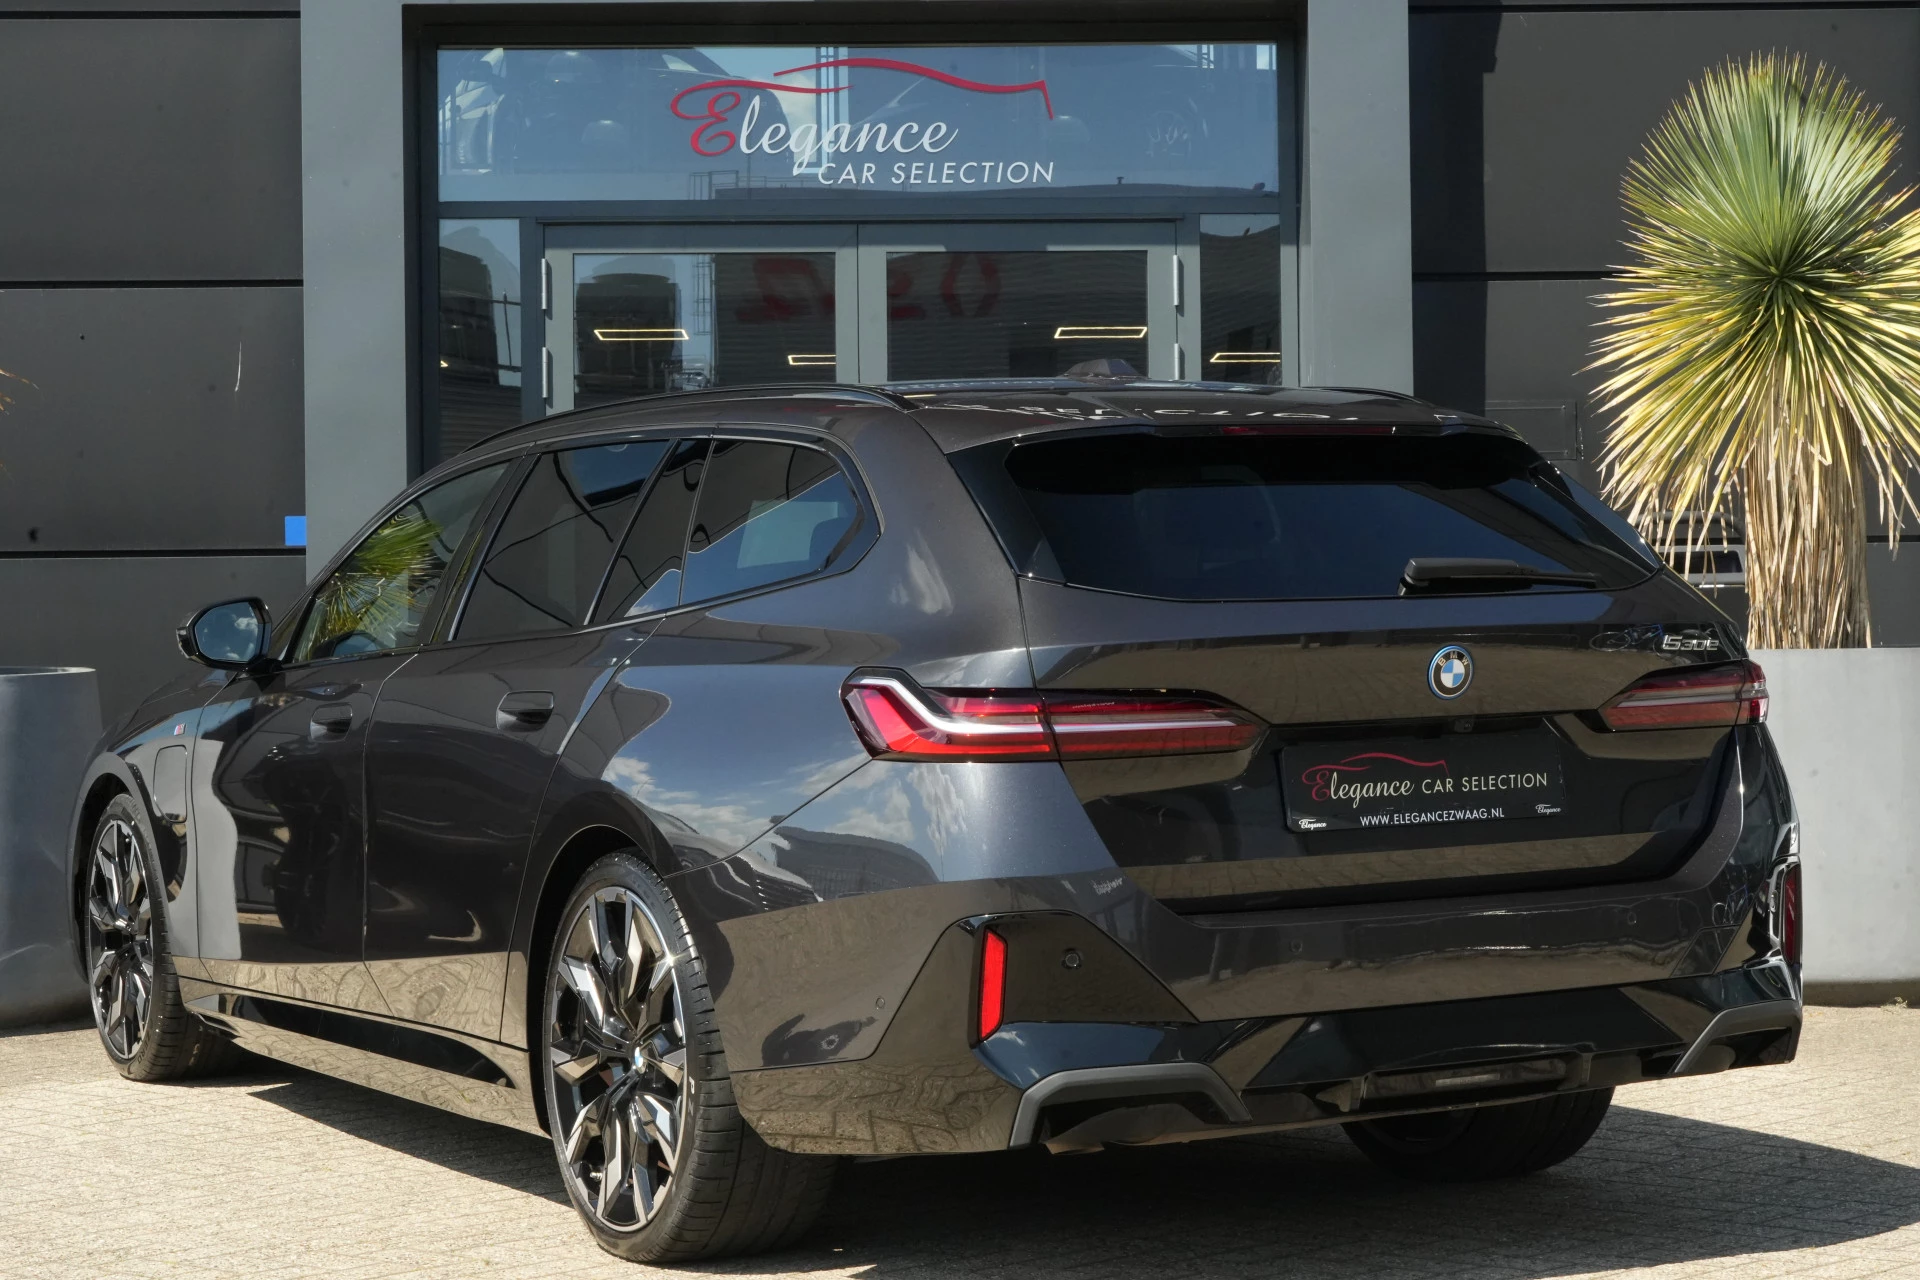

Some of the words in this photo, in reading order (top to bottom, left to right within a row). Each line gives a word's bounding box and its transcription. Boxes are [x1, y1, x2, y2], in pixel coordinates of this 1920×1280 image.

[671, 80, 957, 175] Elegance
[818, 162, 875, 185] CAR
[891, 161, 1055, 185] SELECTION
[1437, 651, 1469, 667] BMW
[1302, 765, 1414, 807] Elegance
[1421, 777, 1454, 795] CAR
[1461, 772, 1549, 793] SELECTION
[1298, 818, 1328, 831] Elegance
[1359, 807, 1505, 827] WWW.ELEGANCEZWAAG.NL
